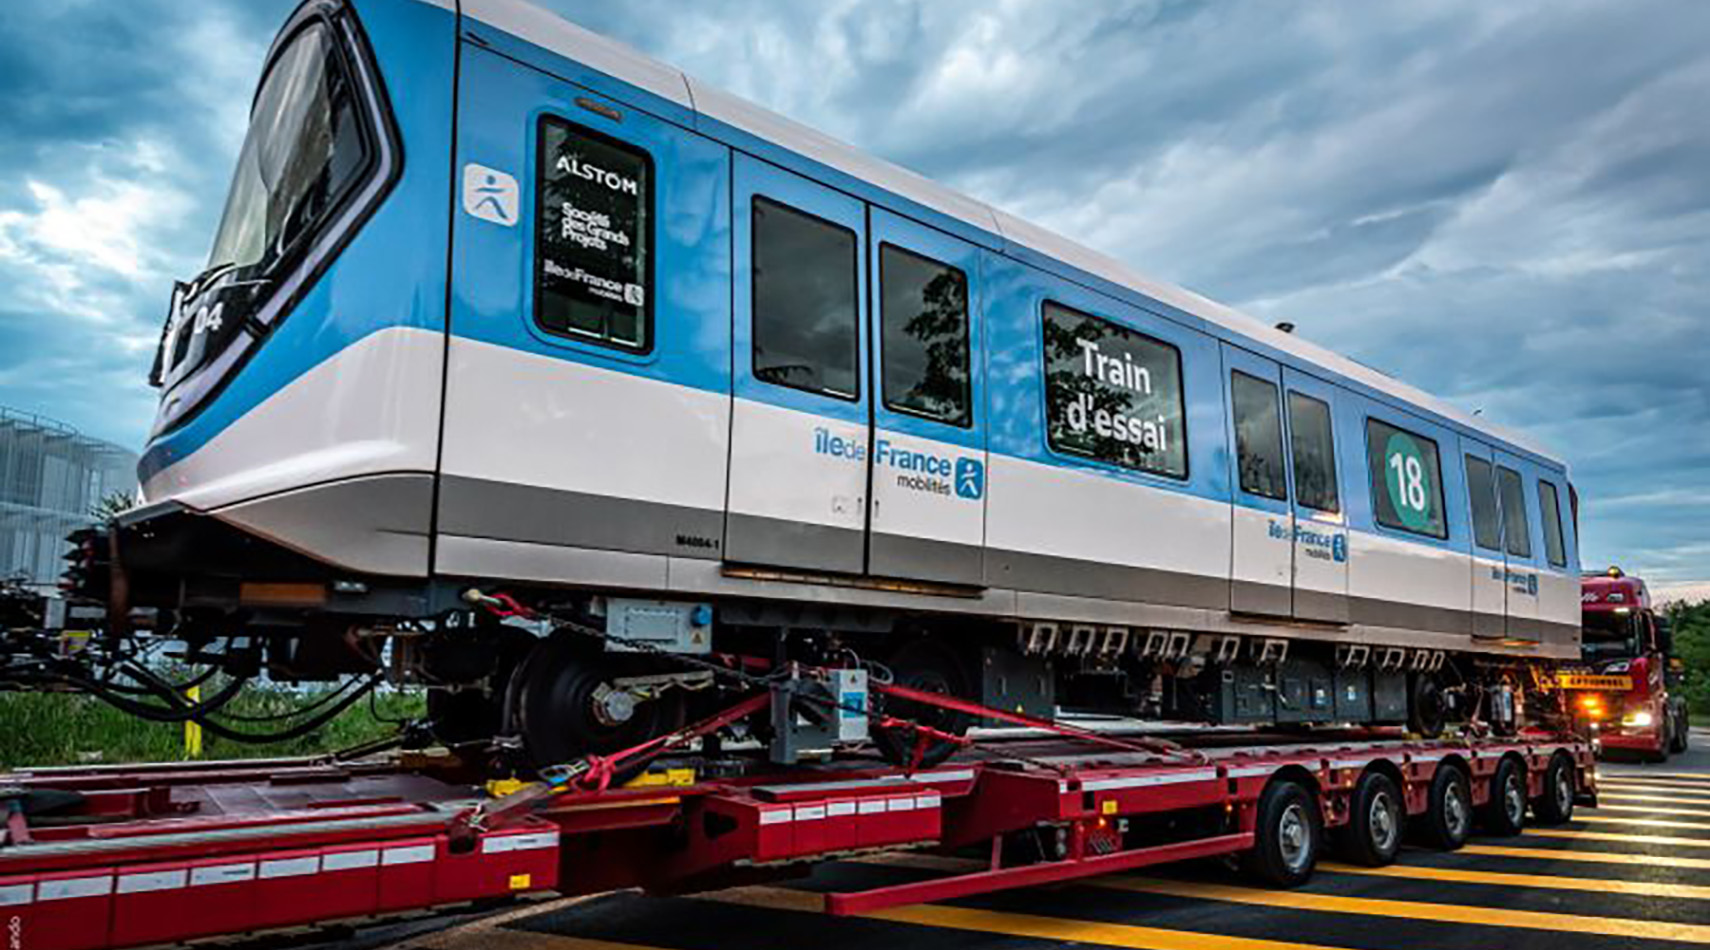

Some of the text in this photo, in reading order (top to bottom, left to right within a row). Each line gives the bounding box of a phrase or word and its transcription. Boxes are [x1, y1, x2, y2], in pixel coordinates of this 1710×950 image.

[556, 156, 638, 196] ALSTOM
[193, 302, 224, 335] 04
[1076, 337, 1152, 394] Train
[1066, 392, 1166, 451] d'essai
[897, 475, 952, 497] mobilités
[1389, 452, 1425, 512] 18
